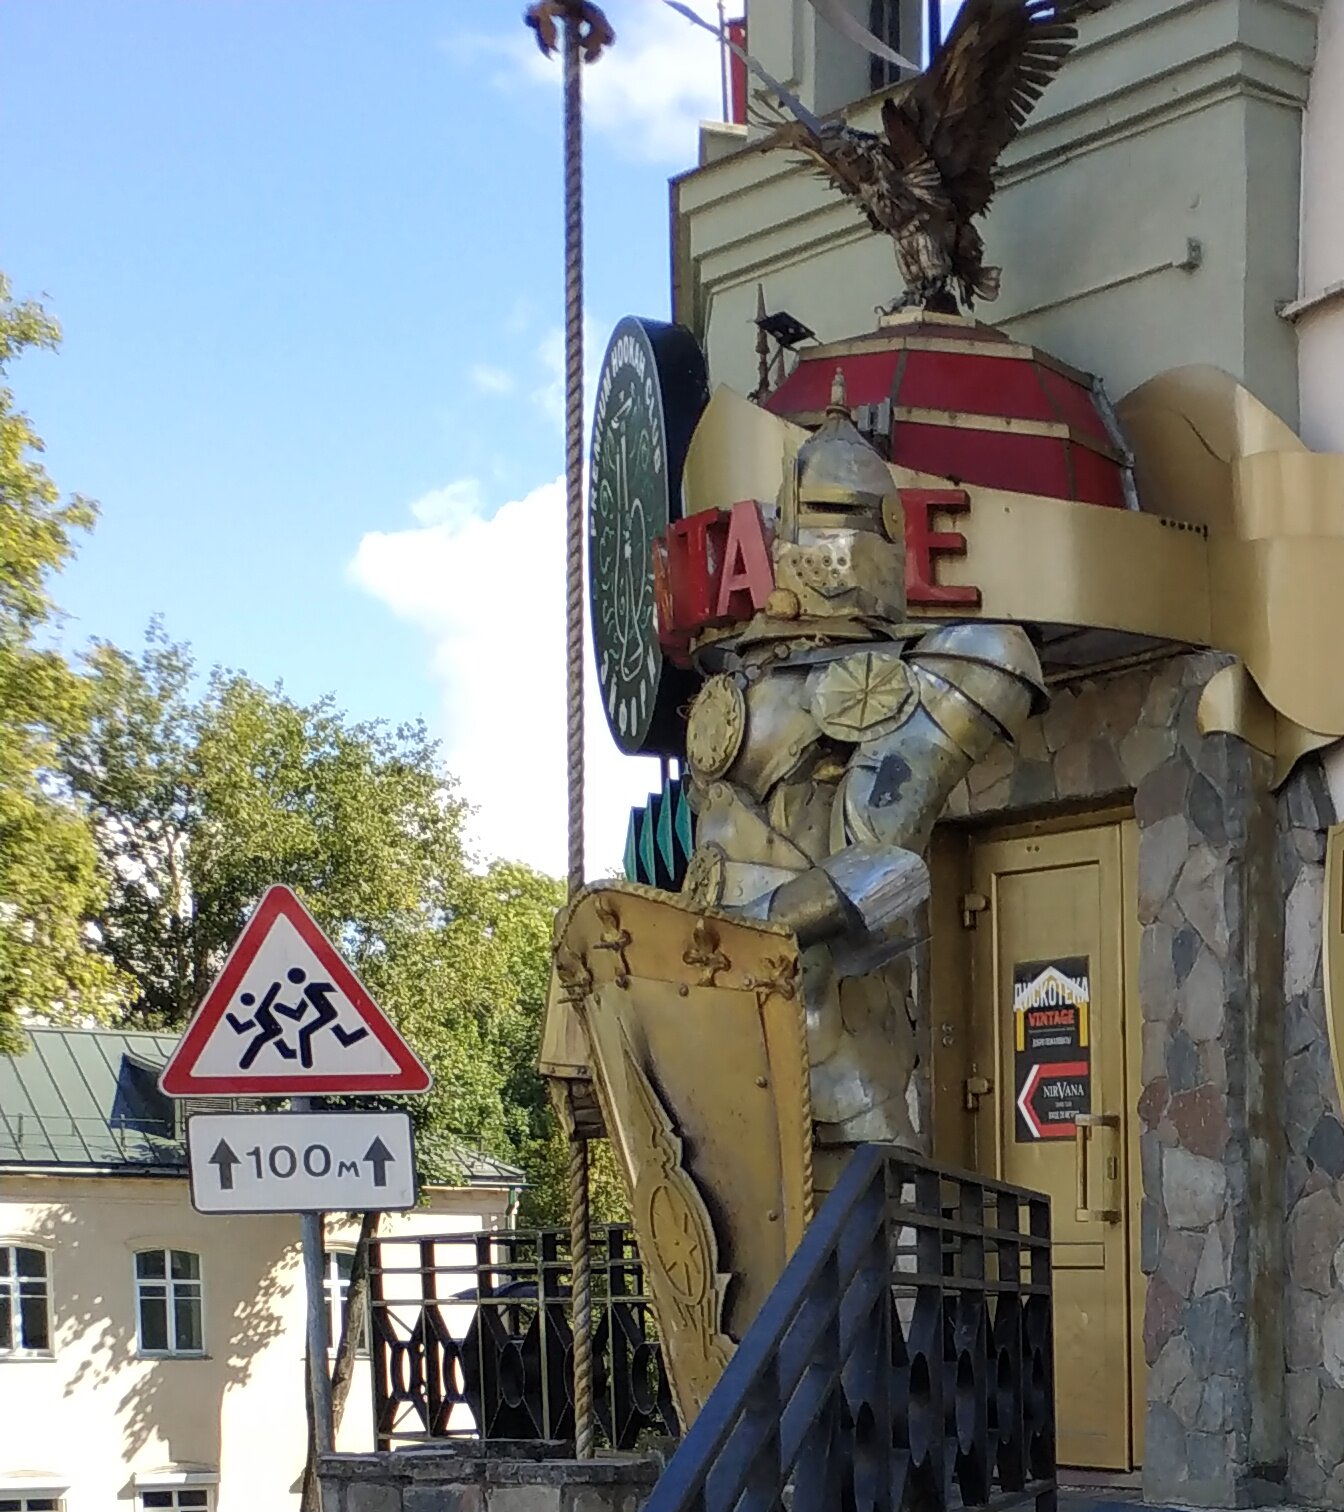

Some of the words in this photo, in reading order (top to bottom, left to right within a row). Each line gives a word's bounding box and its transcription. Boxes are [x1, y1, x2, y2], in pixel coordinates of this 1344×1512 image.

[611, 335, 646, 383] HOOKAH
[645, 377, 661, 474] CLUB
[1013, 976, 1089, 1012] ДИСКОТЕКА
[1028, 1009, 1075, 1027] VINTAGE
[1043, 1082, 1084, 1099] NIRVANA
